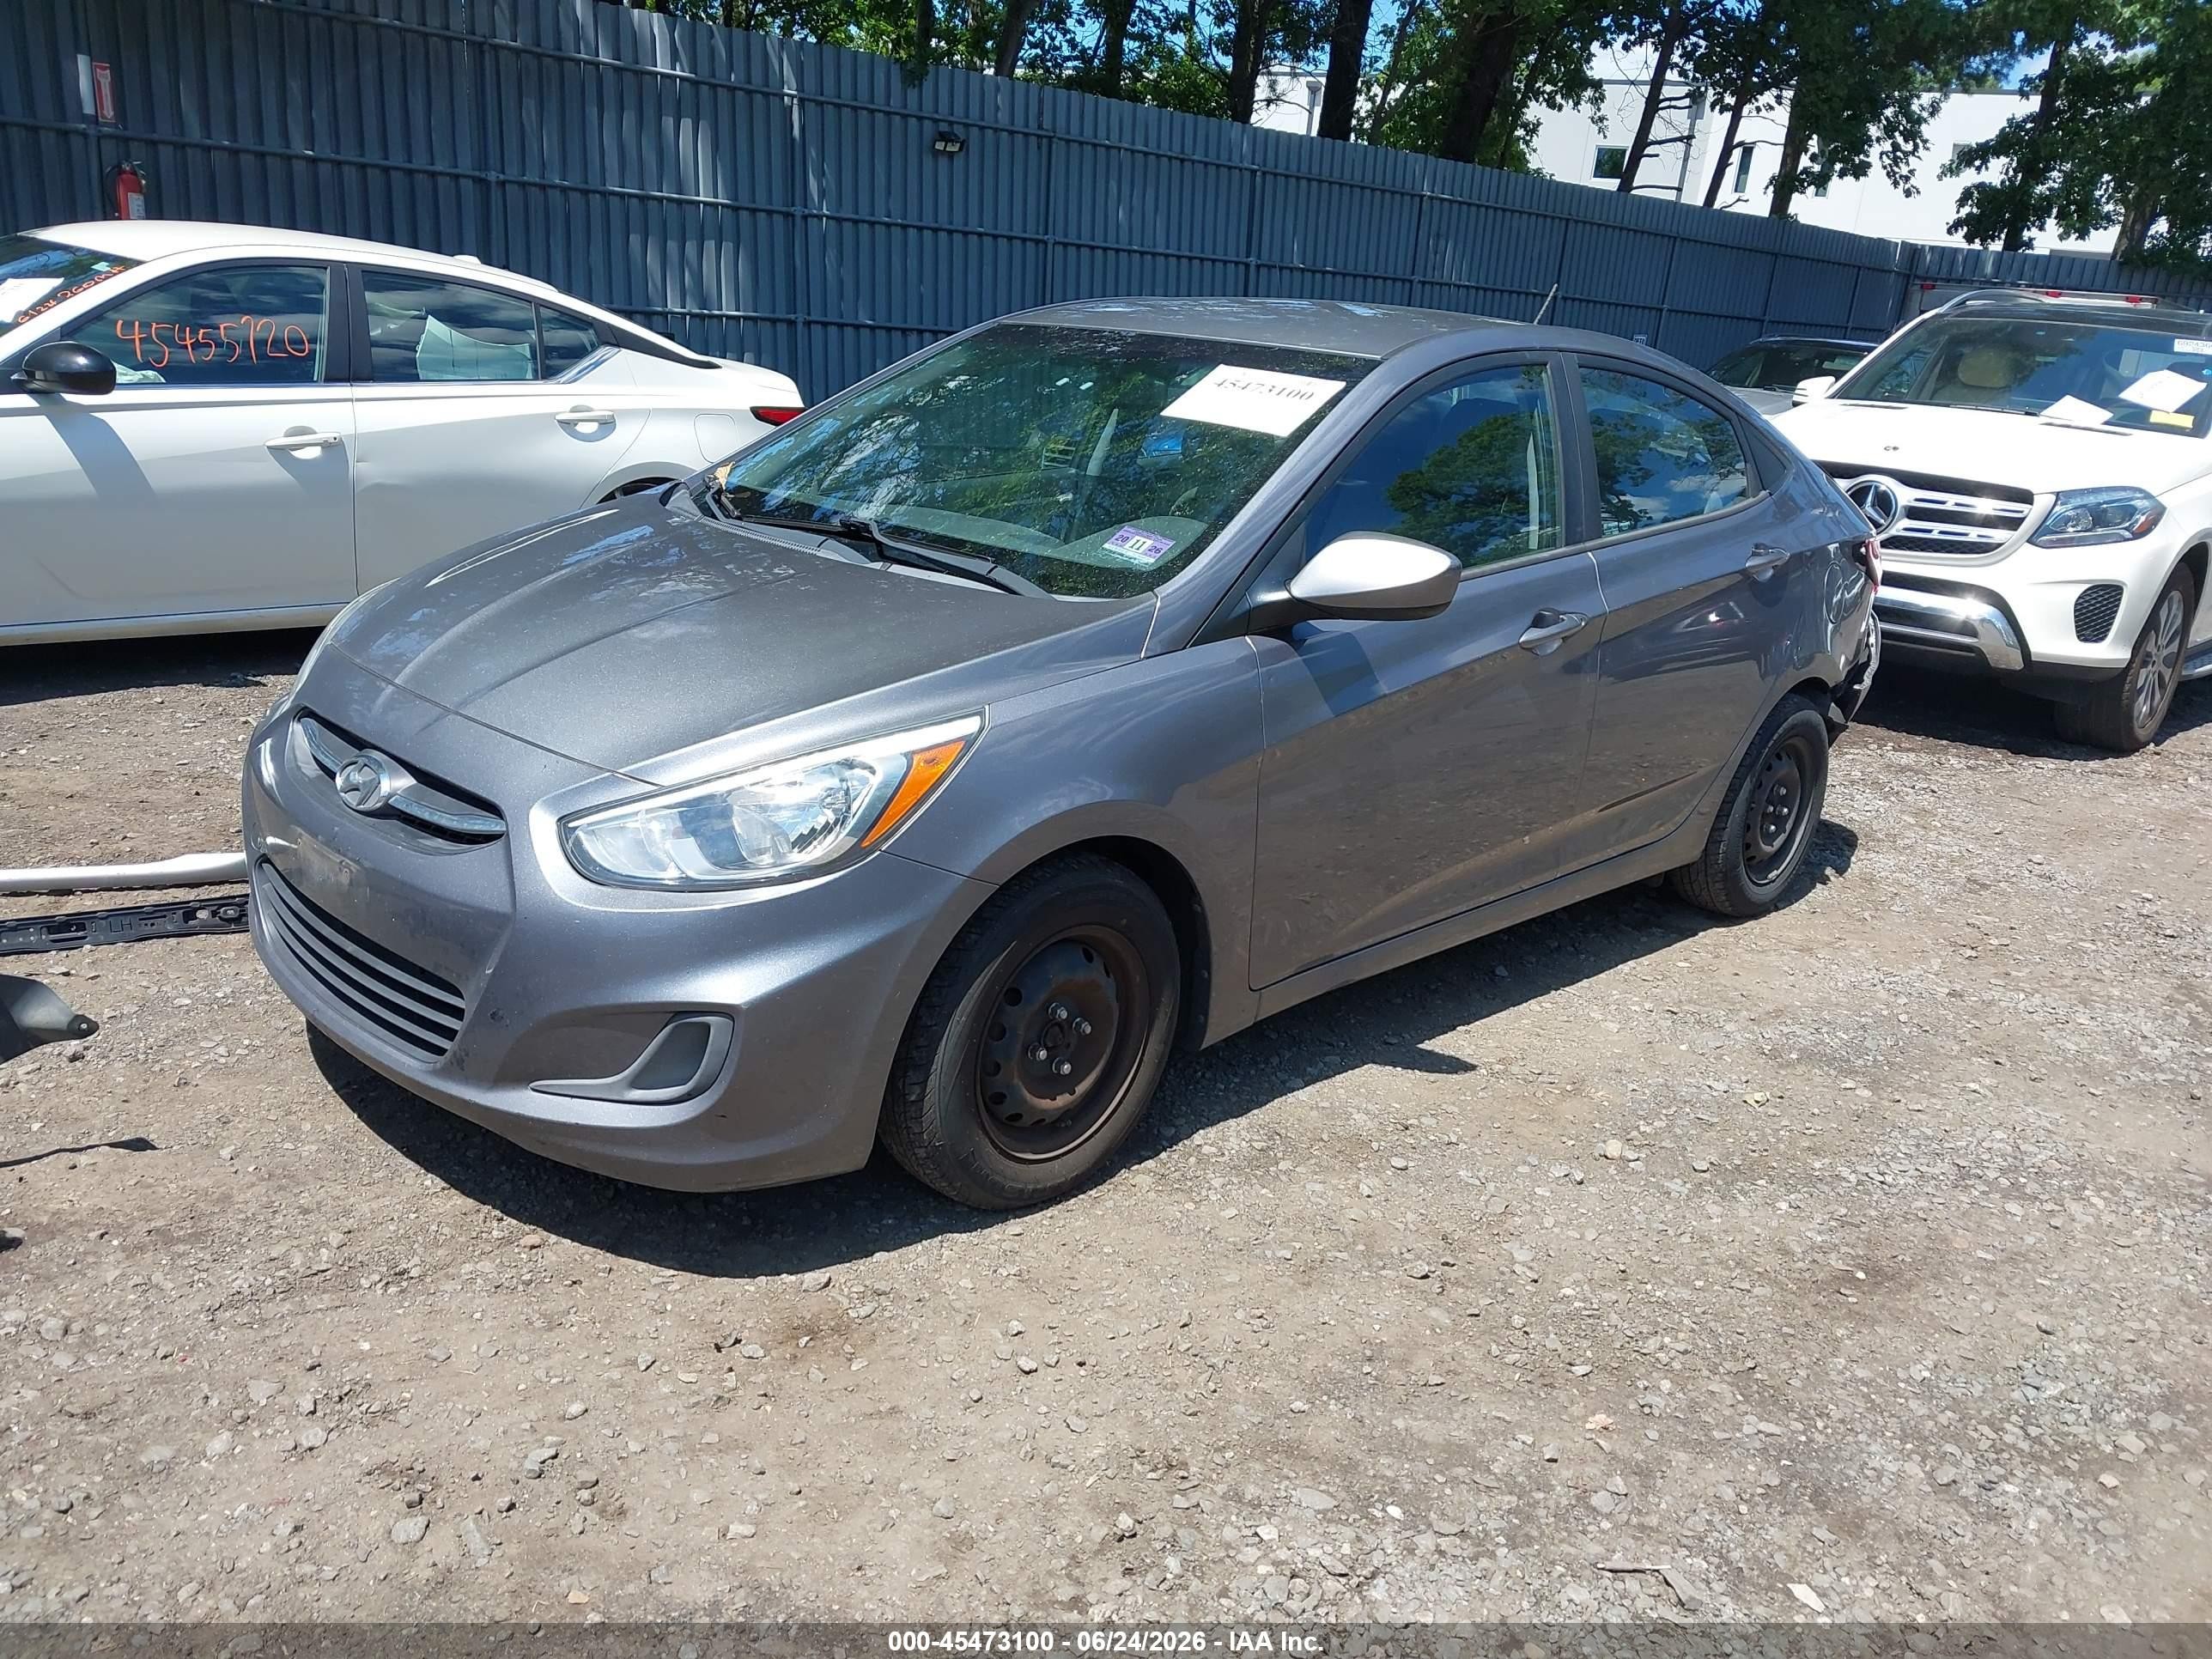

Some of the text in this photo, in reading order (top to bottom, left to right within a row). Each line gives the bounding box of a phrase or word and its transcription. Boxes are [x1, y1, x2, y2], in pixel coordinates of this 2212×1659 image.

[1213, 377, 1315, 401] 45473100
[1115, 534, 1164, 555] 20 11 26
